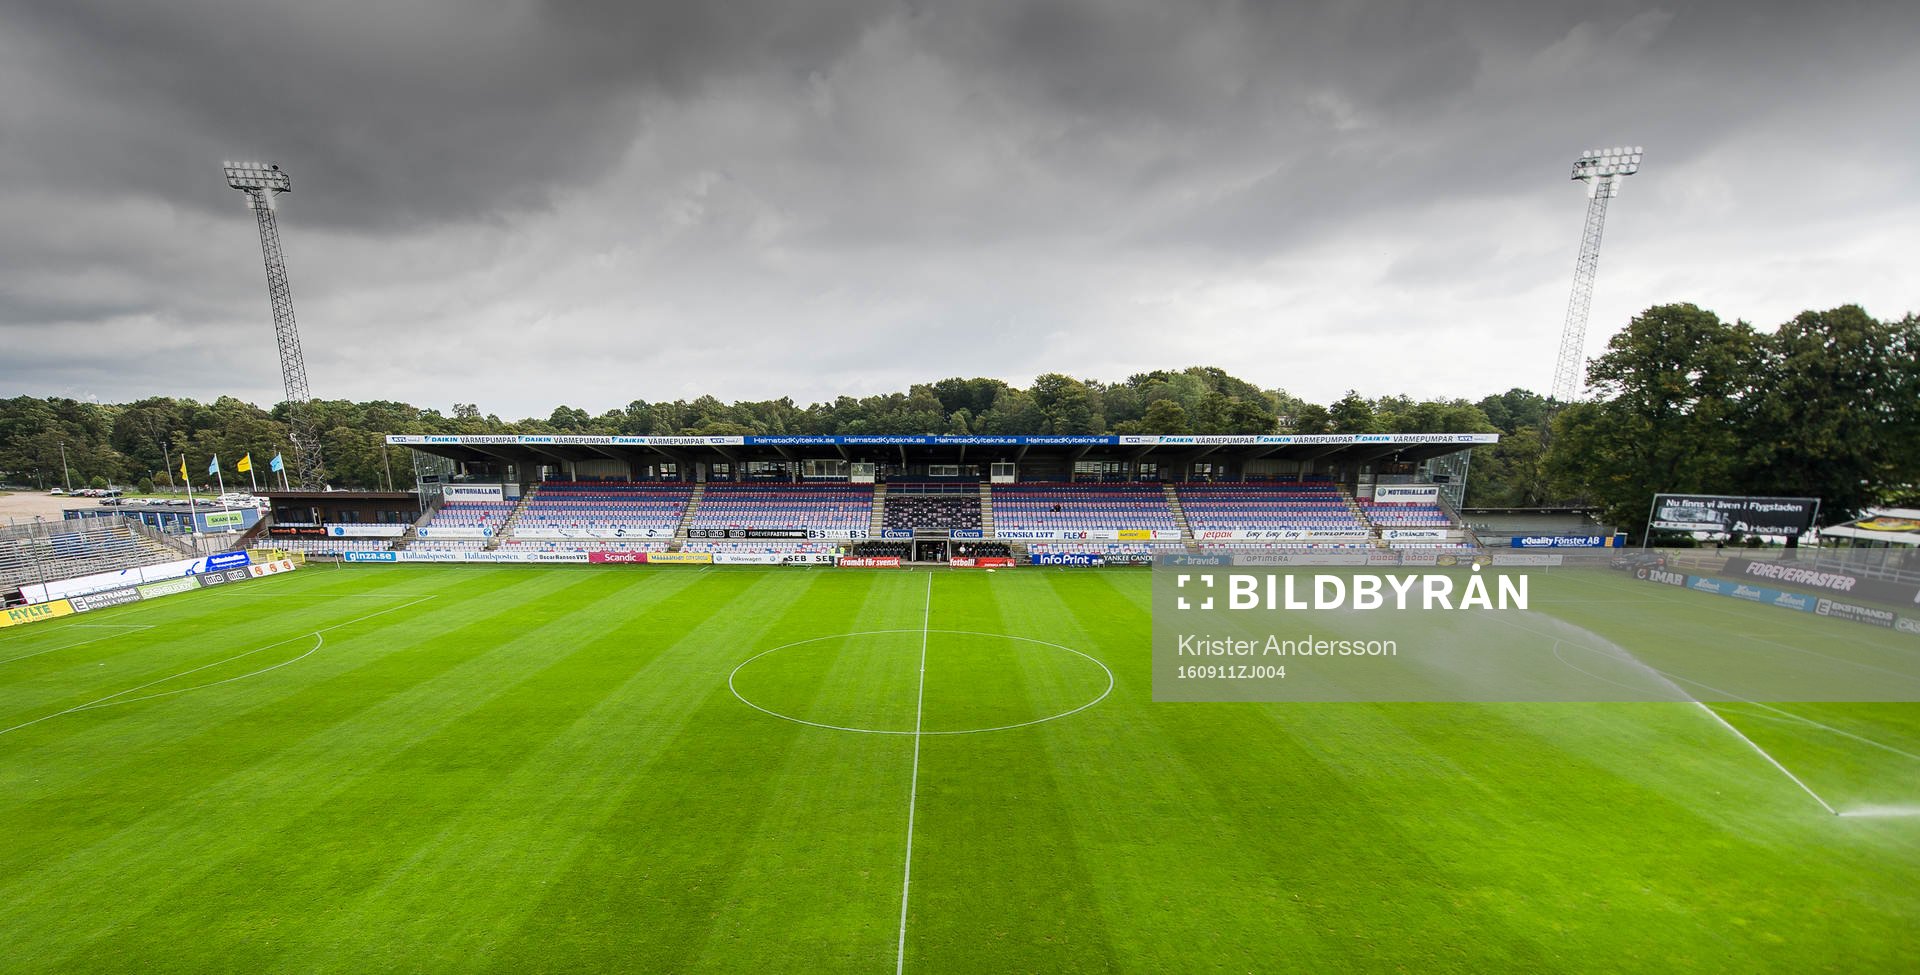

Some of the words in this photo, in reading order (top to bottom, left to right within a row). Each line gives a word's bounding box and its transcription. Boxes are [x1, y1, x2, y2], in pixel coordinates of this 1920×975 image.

[1666, 499, 1679, 507] Nu
[1681, 499, 1705, 508] finns
[1707, 500, 1716, 508] vi
[1717, 501, 1741, 510] även
[1749, 502, 1803, 513] Flygstaden
[211, 515, 239, 523] SKANKA
[1521, 537, 1553, 546] eQuality
[1554, 537, 1587, 545] Fönster
[1588, 537, 1600, 545] AB
[350, 552, 392, 562] ginza.se
[402, 552, 457, 560] Hallandsposten
[464, 552, 519, 560] Hallandsposten
[604, 553, 636, 562] Scandic
[1187, 556, 1219, 565] bravida
[840, 557, 865, 566] Framåt
[865, 557, 876, 566] för
[877, 557, 900, 566] svensk
[1650, 569, 1684, 586] IMAB
[8, 604, 53, 621] HYLTE
[1831, 602, 1894, 620] EKSTRANDS
